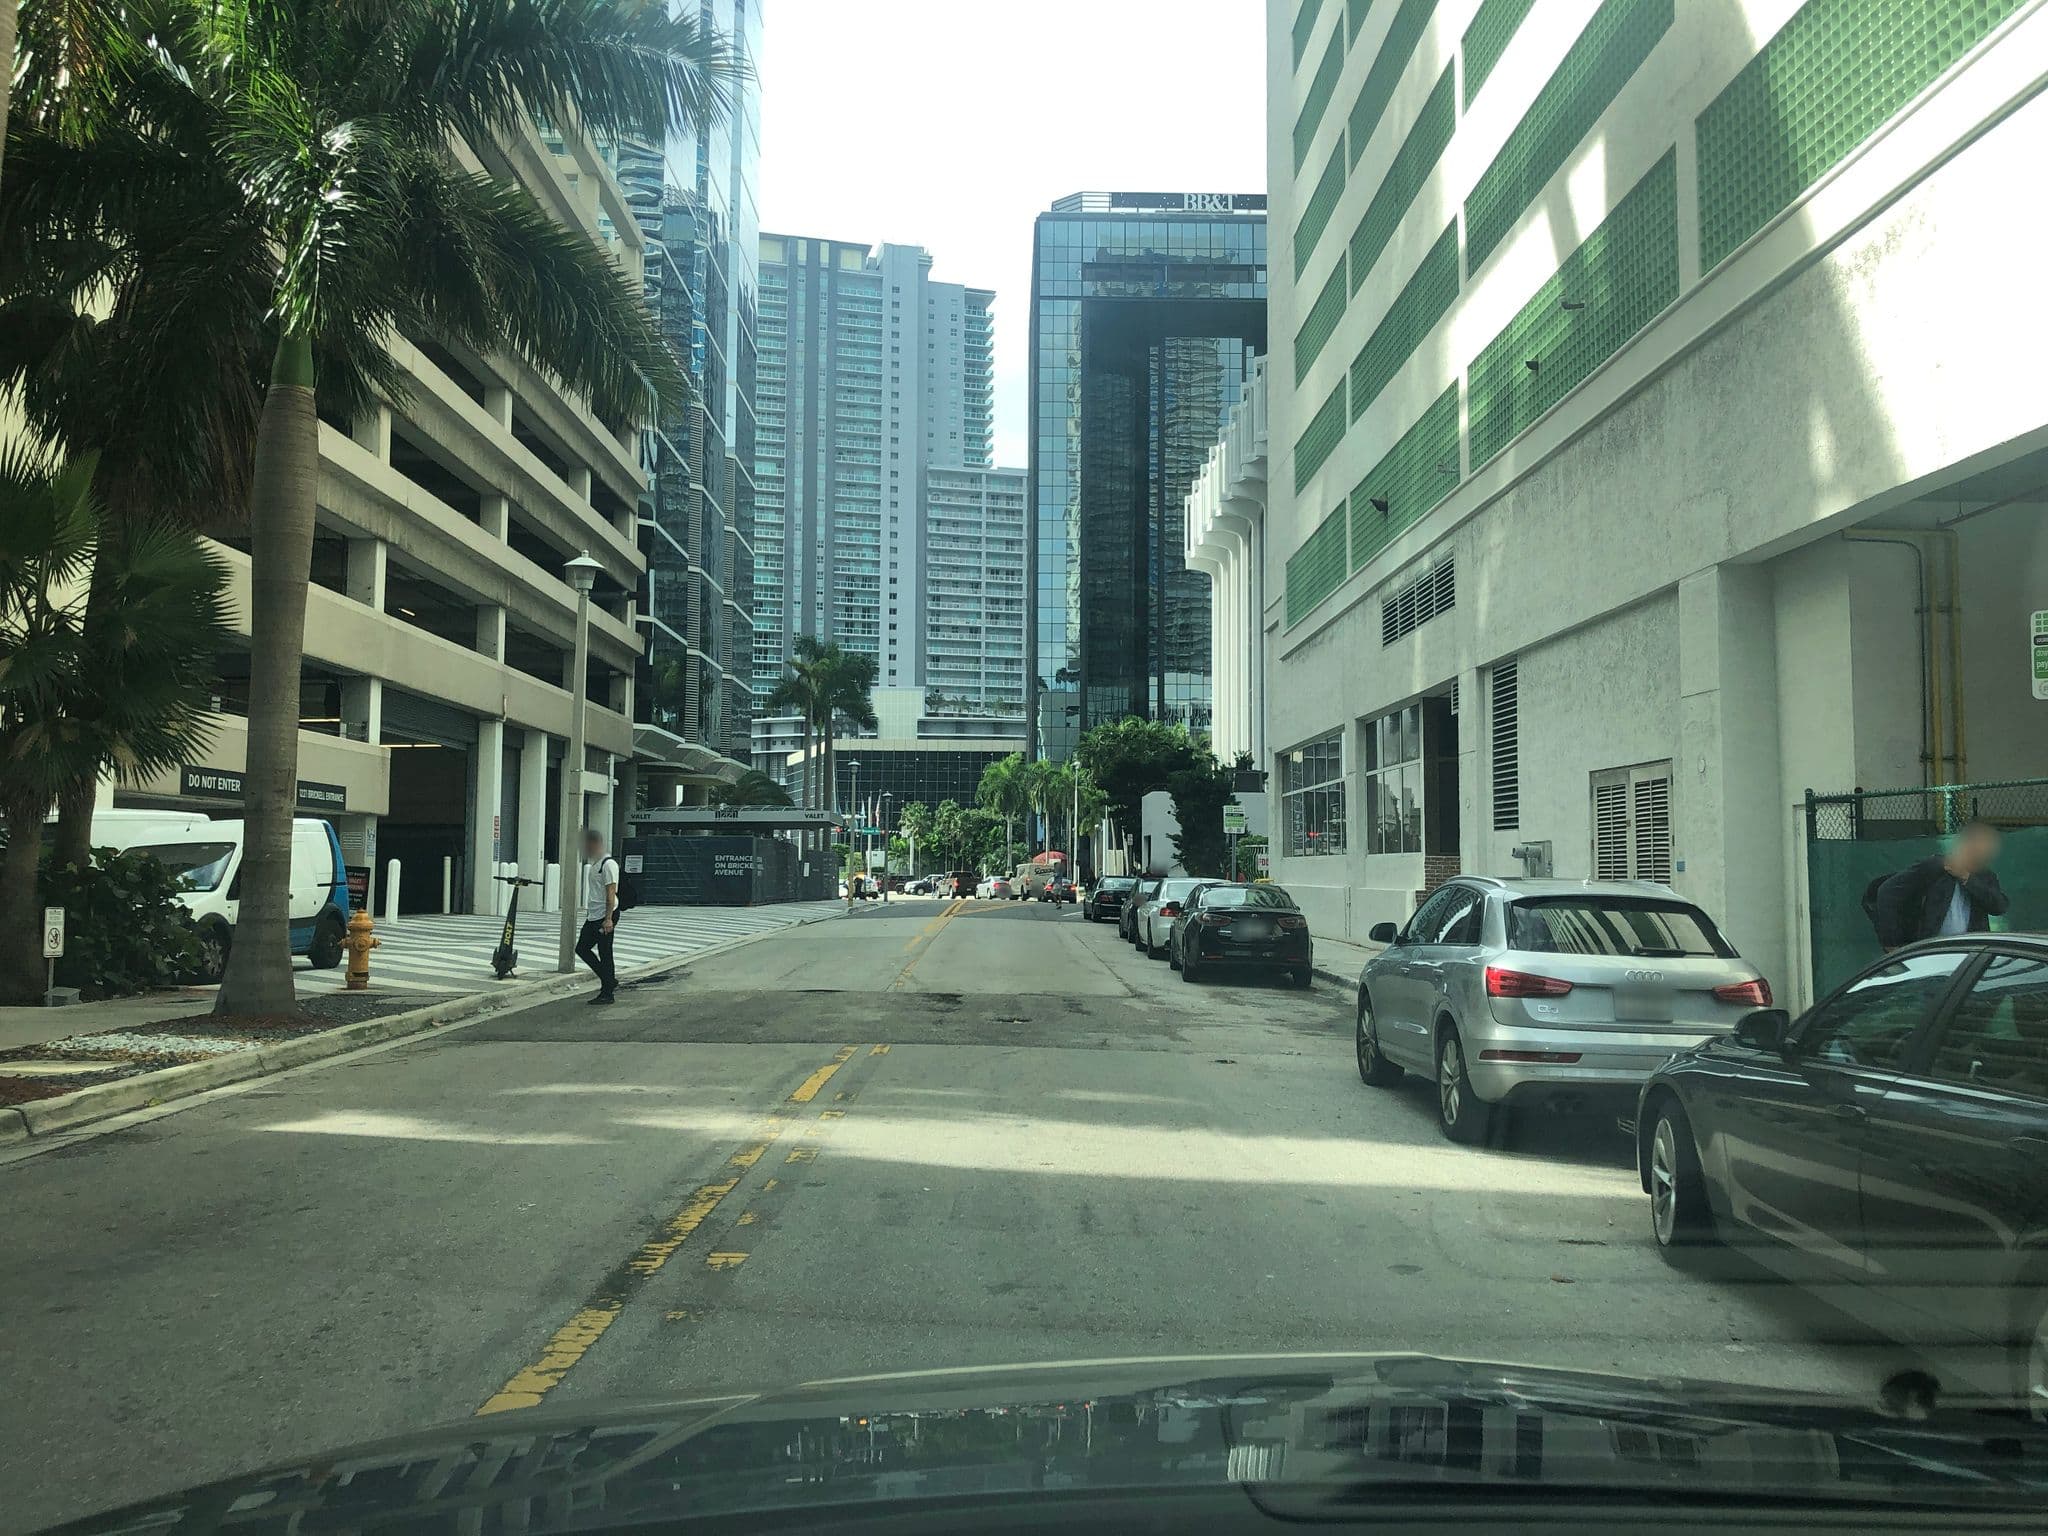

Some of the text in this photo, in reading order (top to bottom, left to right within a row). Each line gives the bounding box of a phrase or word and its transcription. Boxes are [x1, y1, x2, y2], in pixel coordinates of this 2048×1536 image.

[1183, 193, 1238, 211] BB&T
[188, 774, 241, 792] DO NOT ENTER
[714, 854, 754, 862] ENTRANCE
